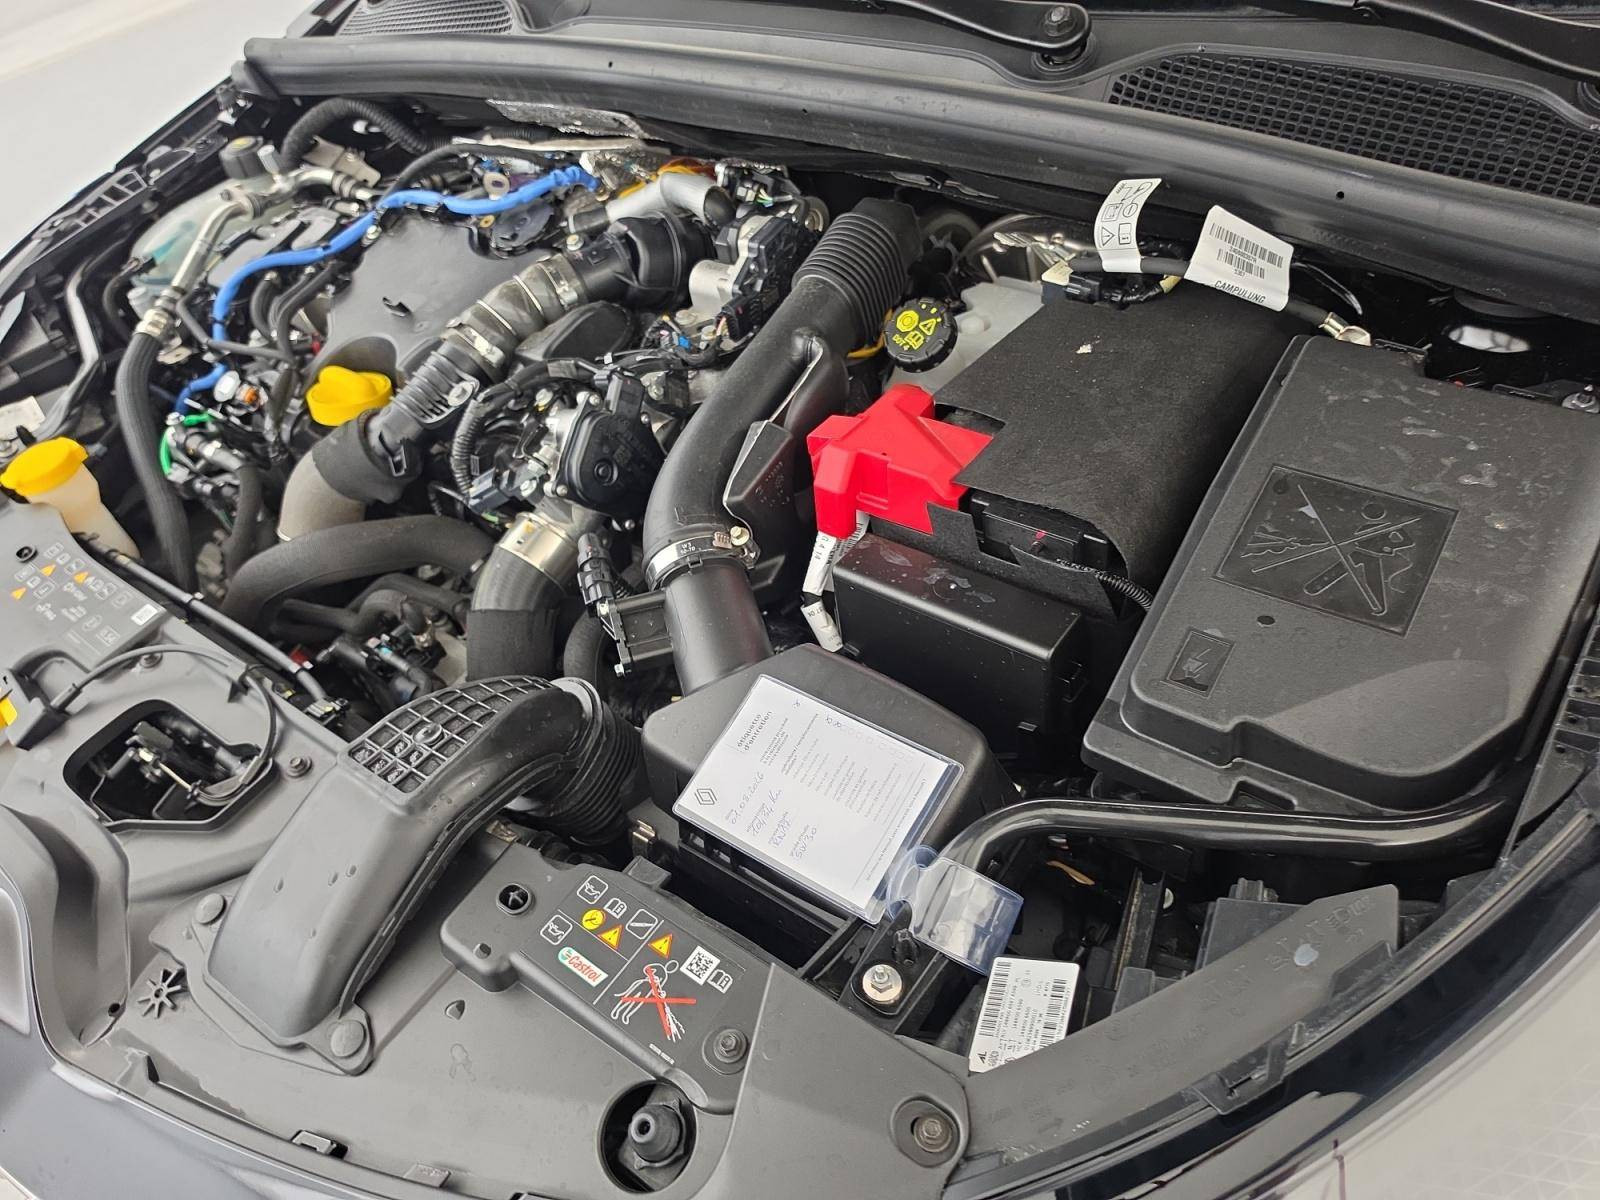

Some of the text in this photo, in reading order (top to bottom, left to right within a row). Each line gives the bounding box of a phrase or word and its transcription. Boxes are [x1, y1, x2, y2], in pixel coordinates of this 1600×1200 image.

[1214, 279, 1266, 304] CAMPULUNG
[892, 334, 905, 345] DOT
[744, 711, 773, 750] d'entretien
[567, 954, 601, 981] Castrol
